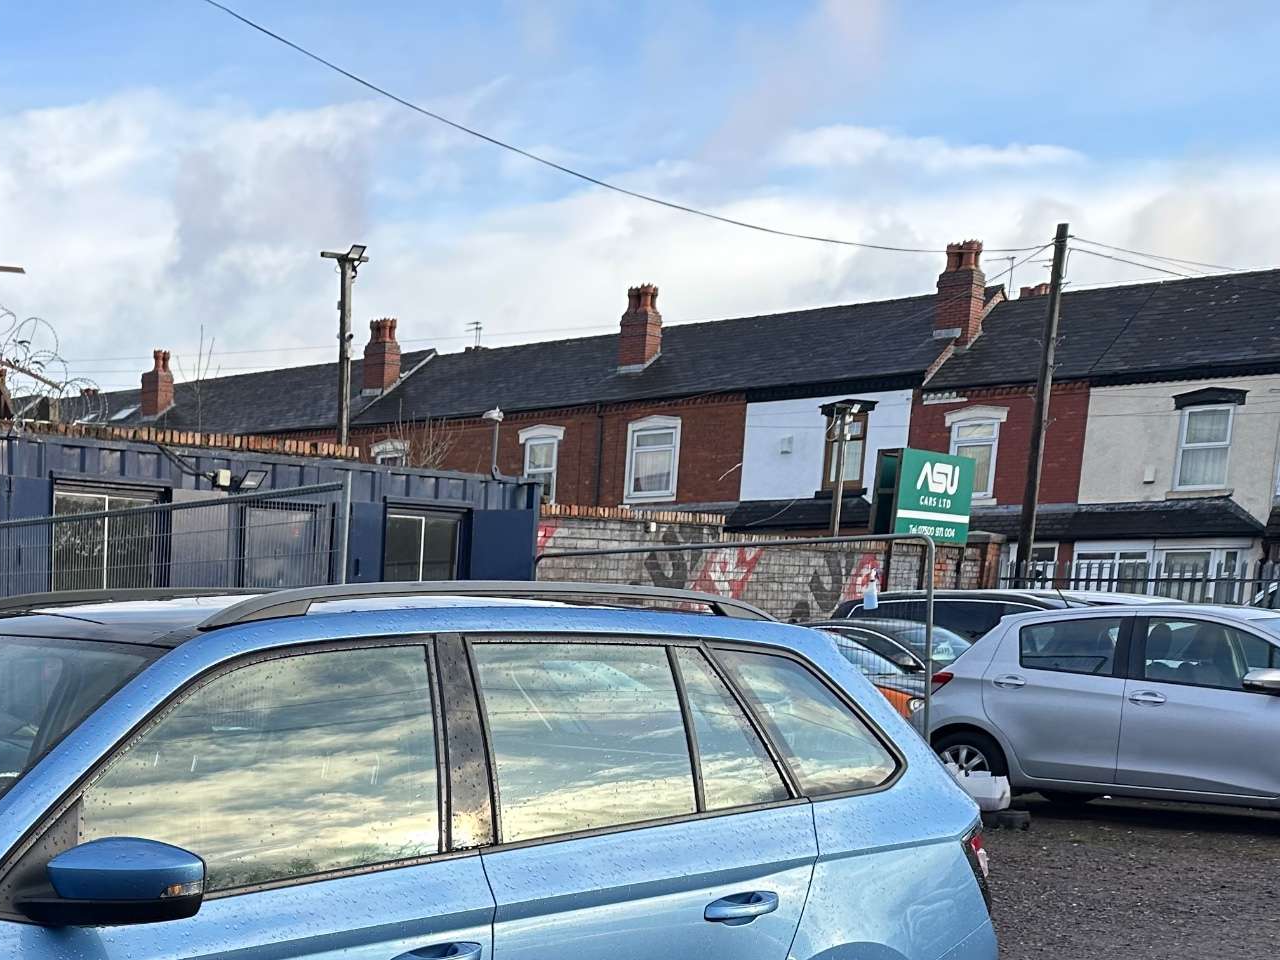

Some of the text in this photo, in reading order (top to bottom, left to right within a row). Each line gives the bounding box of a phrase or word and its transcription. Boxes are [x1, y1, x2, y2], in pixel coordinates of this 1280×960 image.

[916, 461, 960, 495] ASU
[920, 496, 951, 509] CARS LTD
